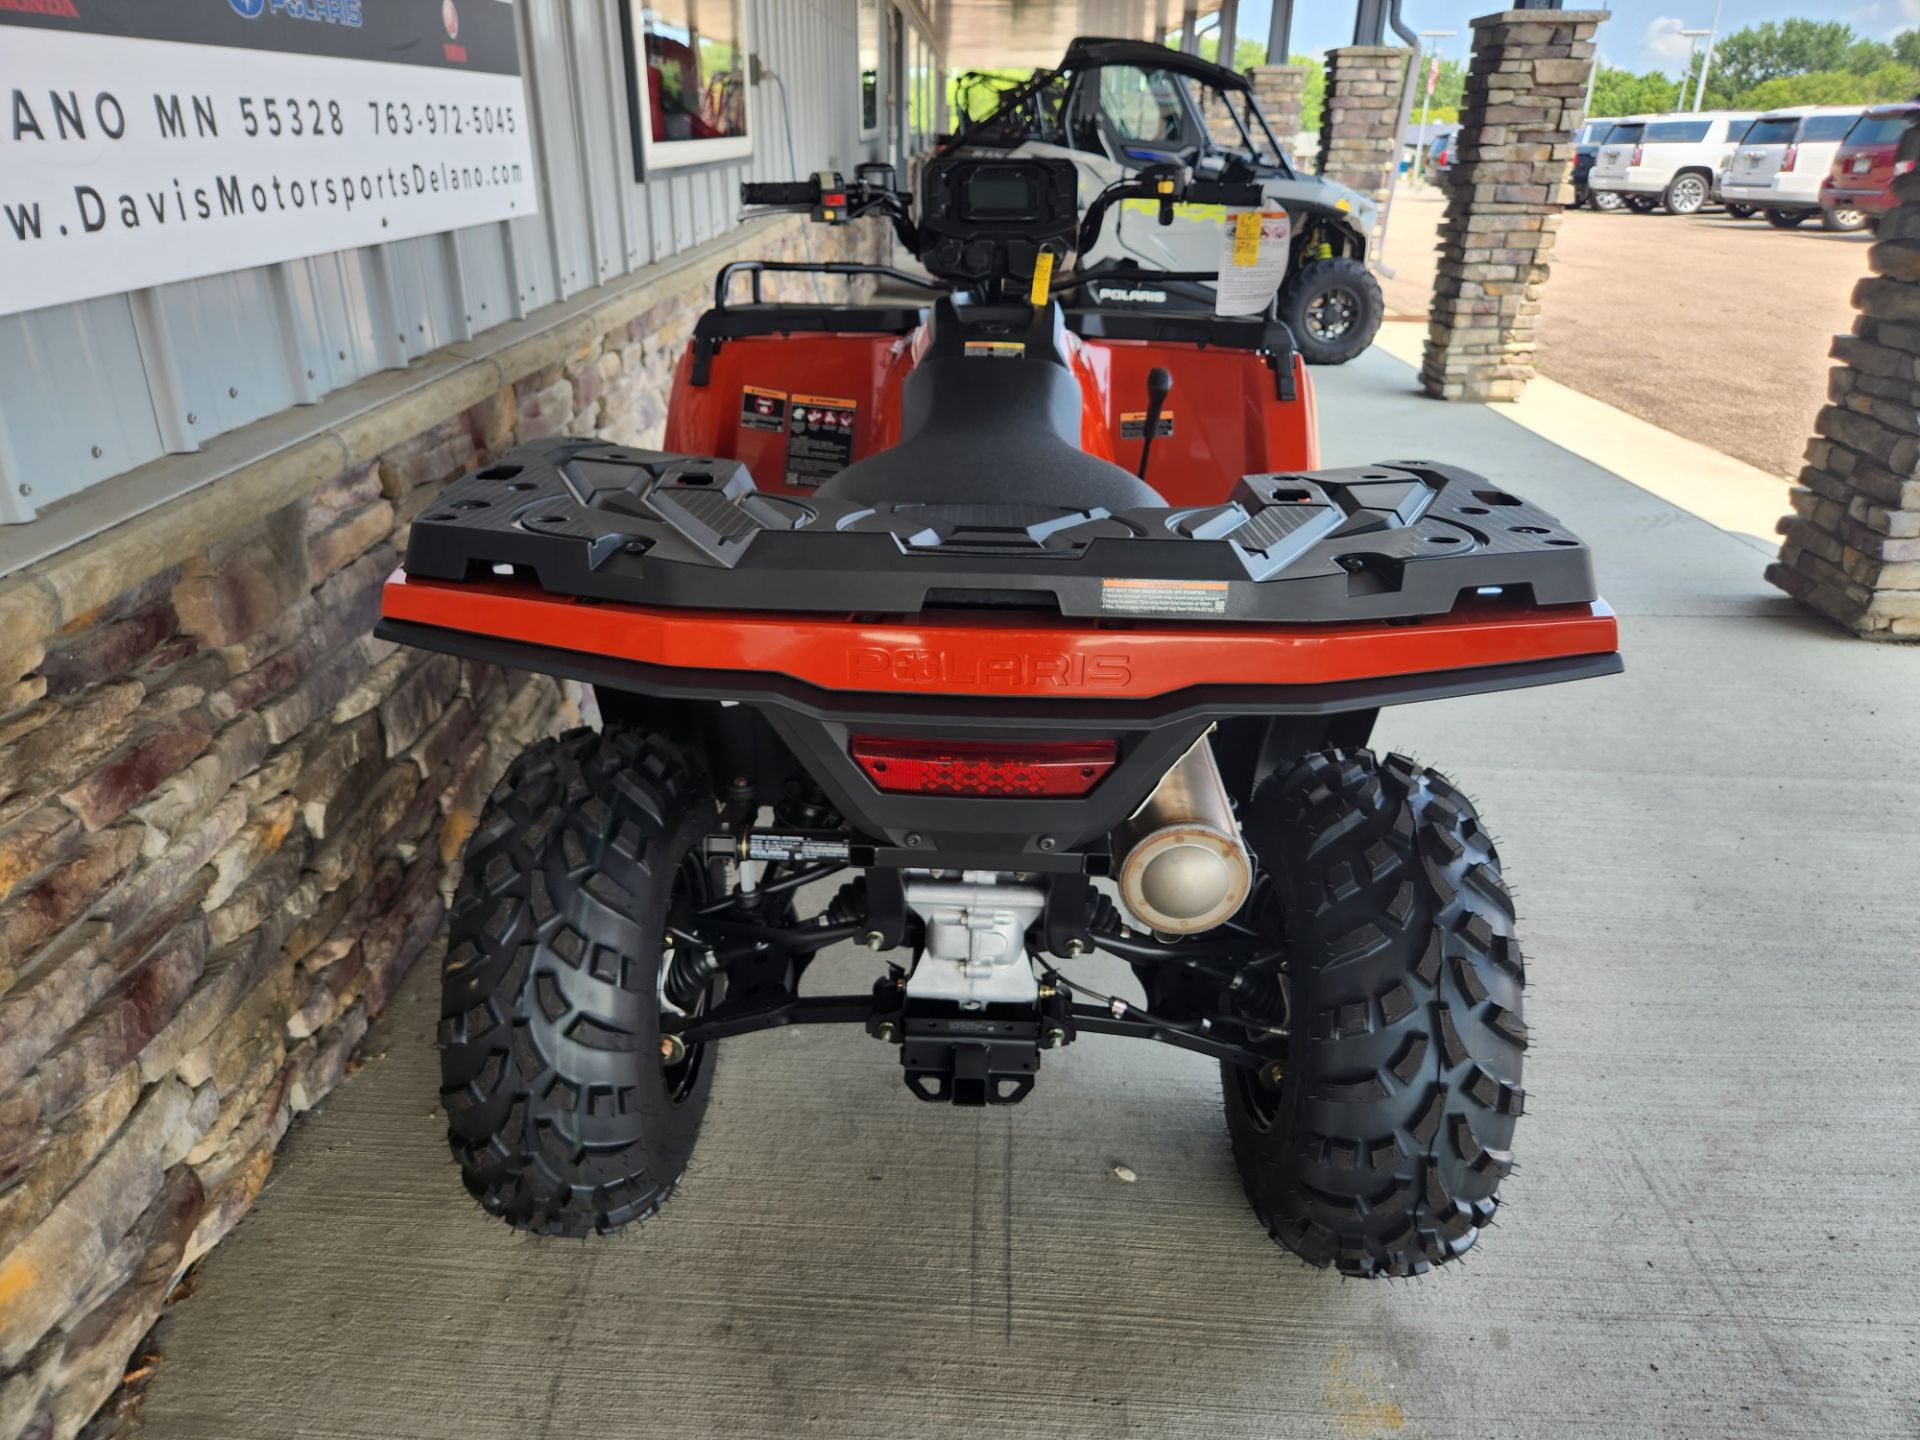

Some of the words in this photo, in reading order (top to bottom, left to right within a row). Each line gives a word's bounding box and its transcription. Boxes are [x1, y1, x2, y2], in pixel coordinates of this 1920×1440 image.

[152, 93, 218, 138] MN
[239, 96, 344, 136] 55328
[368, 101, 516, 135] 763-972-5045
[1099, 287, 1167, 303] POLARIS
[847, 648, 1132, 687] POLARIS
